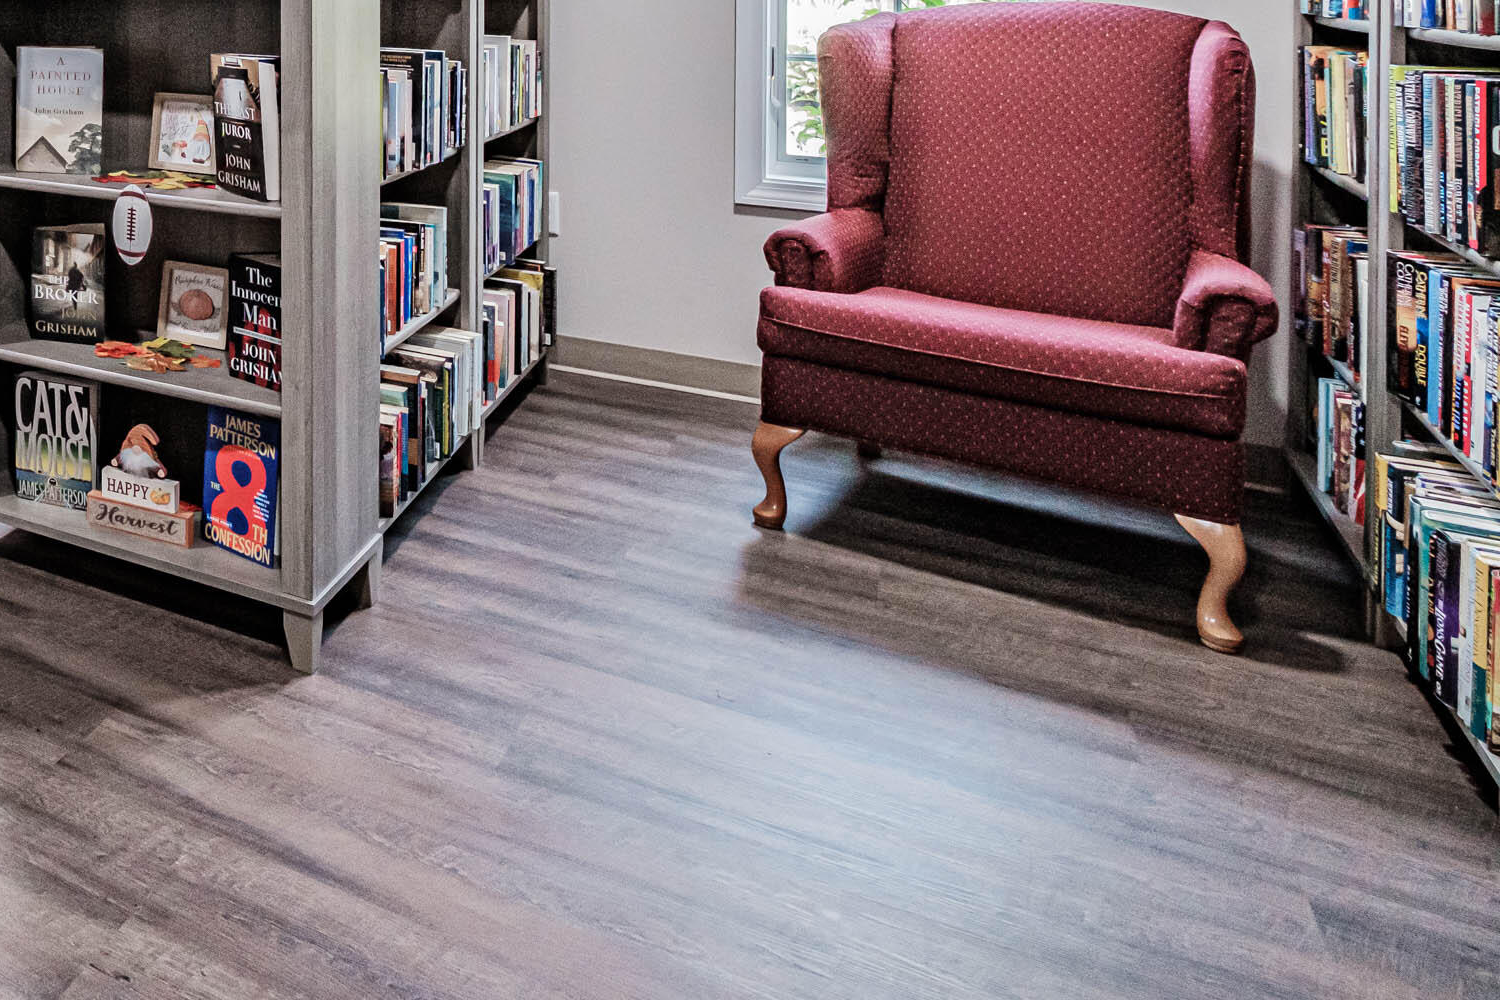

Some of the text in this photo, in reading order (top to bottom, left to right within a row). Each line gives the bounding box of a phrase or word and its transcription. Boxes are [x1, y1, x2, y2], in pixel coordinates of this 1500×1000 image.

[55, 55, 66, 66] A
[30, 70, 92, 82] PAINTED
[36, 85, 85, 97] HOUSE
[34, 106, 84, 117] John Grisham
[1404, 74, 1416, 148] PATRICIA CORNWELL
[221, 121, 253, 141] JUROR
[225, 152, 252, 171] JOHN
[217, 171, 262, 194] GRISHAM
[245, 266, 274, 289] The
[1396, 261, 1405, 306] COULTER
[1404, 263, 1415, 306] CATHERINE
[33, 284, 100, 306] BROKER
[1415, 271, 1427, 320] CATHERINE
[60, 308, 98, 321] JOHN
[242, 302, 278, 331] Man
[34, 319, 98, 339] GRISHAM
[242, 341, 278, 365] JOHN
[1417, 344, 1427, 387] DOUBLE
[15, 377, 89, 448] CAT&
[225, 414, 261, 438] JAMES
[209, 422, 277, 461] PATTERSON
[15, 428, 92, 482] MOUSE
[18, 477, 43, 498] JAMES
[106, 476, 149, 501] HAPPY
[210, 481, 222, 491] THE
[211, 444, 267, 535] 8
[95, 503, 180, 537] Harvest
[204, 522, 271, 566] CONFESSION
[252, 523, 269, 546] TH
[1435, 639, 1446, 679] GAME
